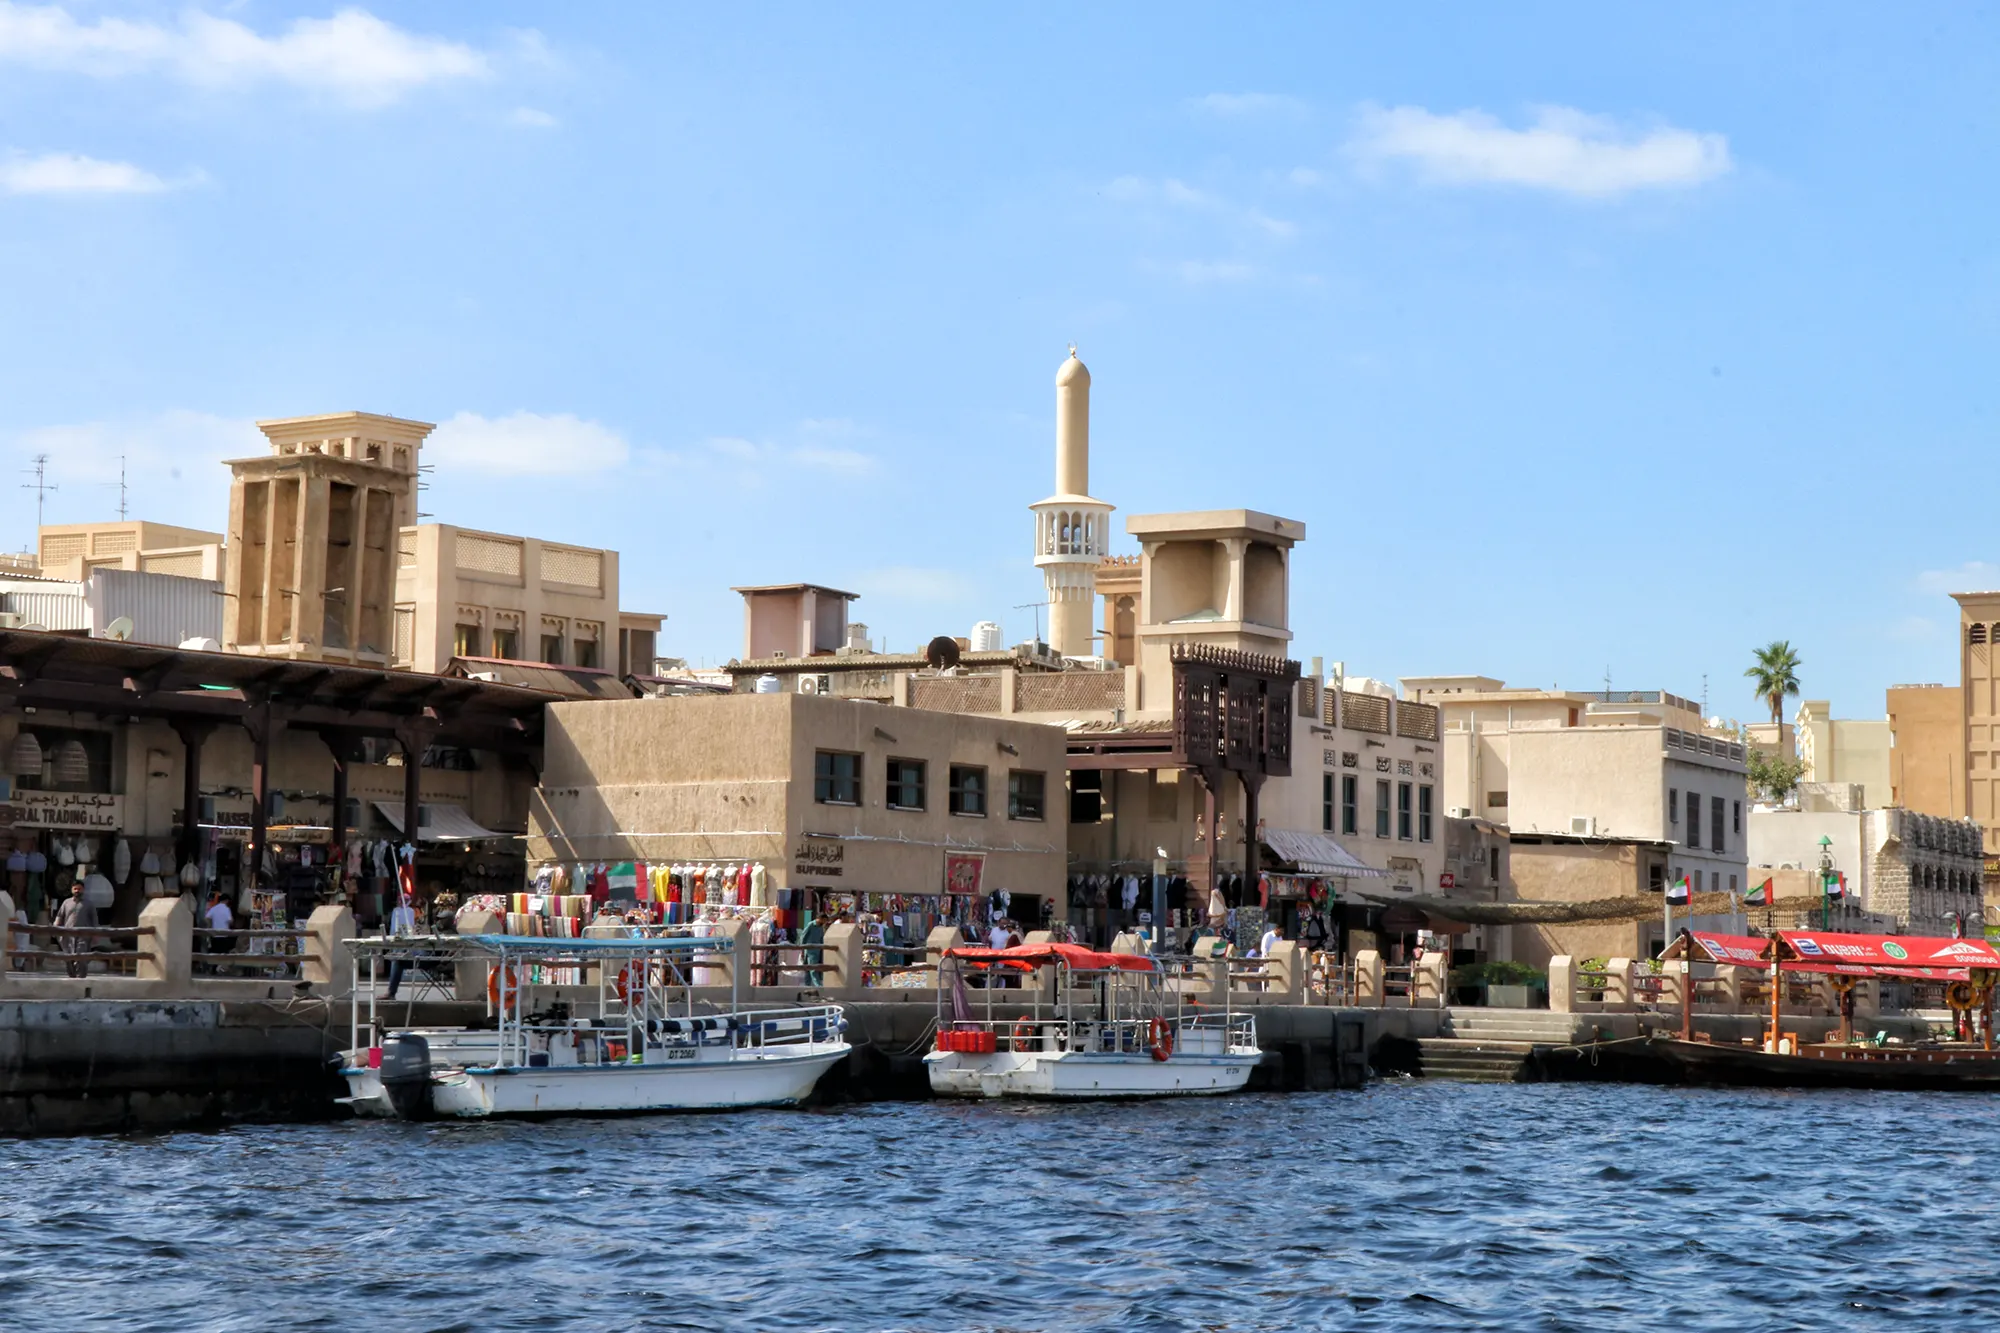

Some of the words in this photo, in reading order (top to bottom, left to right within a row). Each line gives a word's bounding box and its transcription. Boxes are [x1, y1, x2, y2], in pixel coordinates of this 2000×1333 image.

[14, 808, 40, 822] ERAL
[42, 808, 87, 824] TRADING
[796, 865, 843, 876] SUPREME
